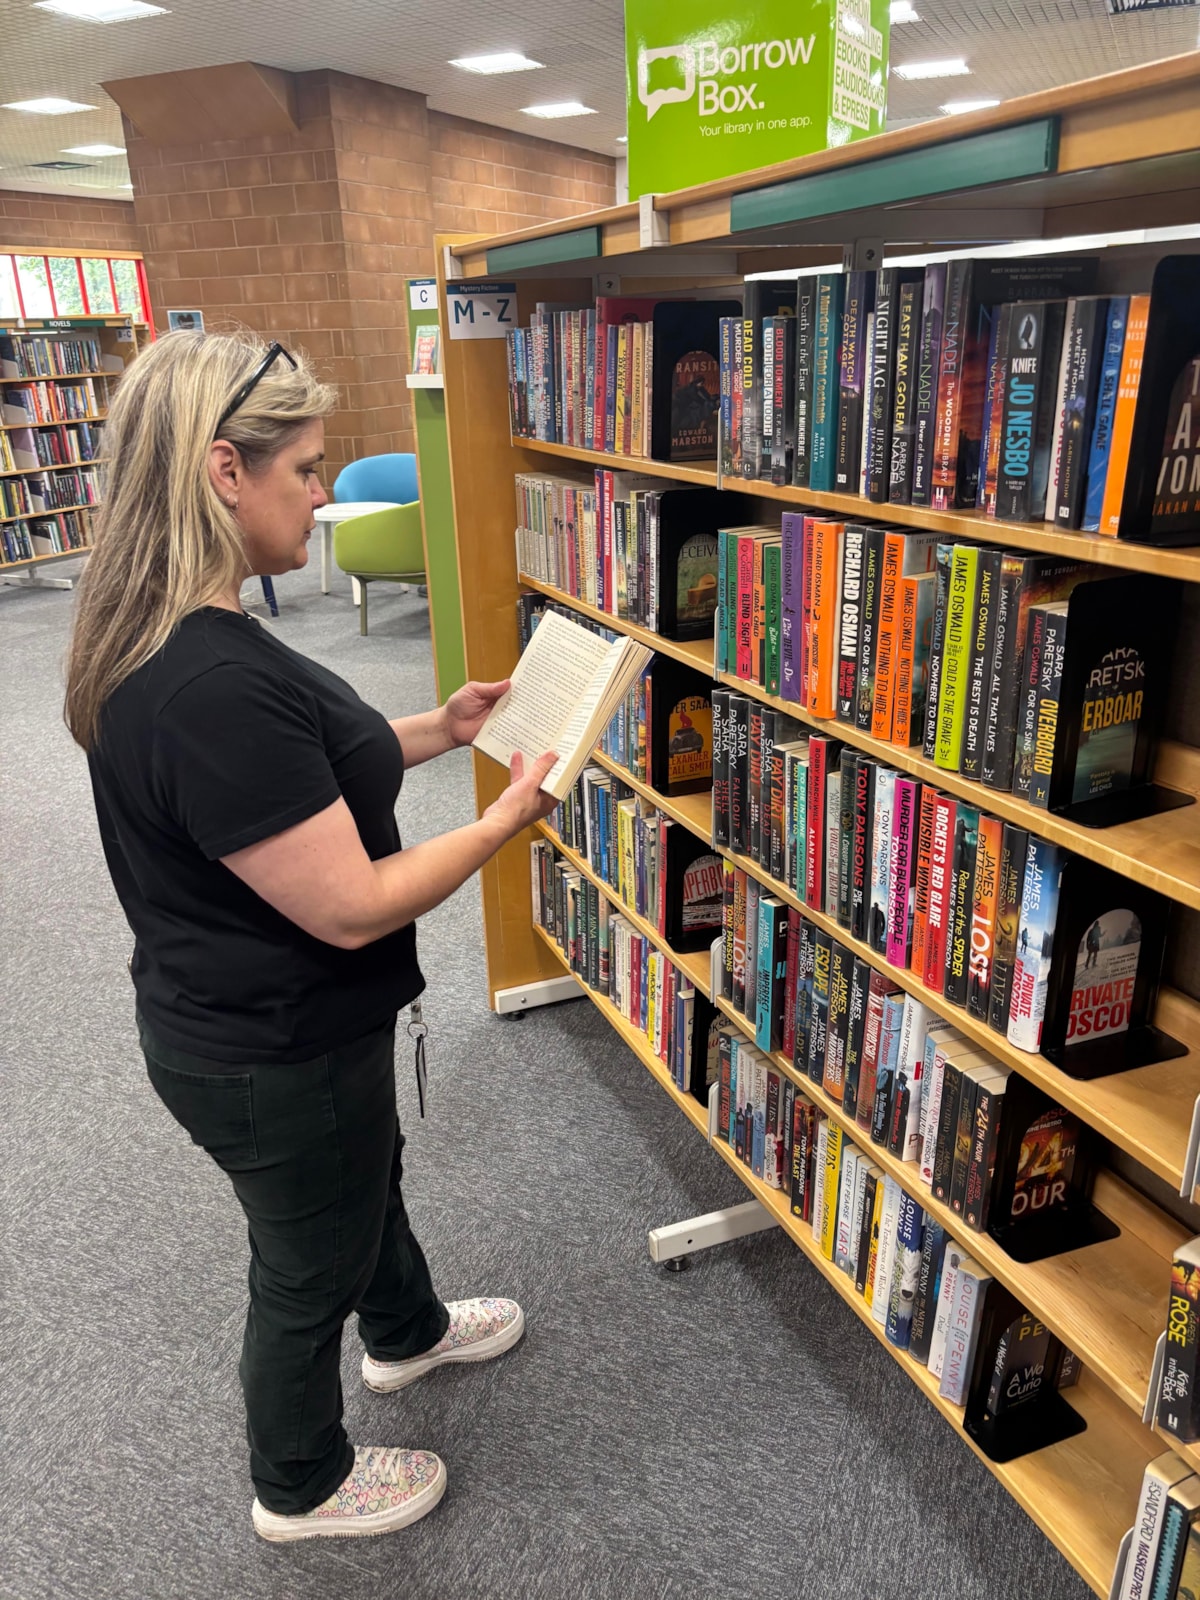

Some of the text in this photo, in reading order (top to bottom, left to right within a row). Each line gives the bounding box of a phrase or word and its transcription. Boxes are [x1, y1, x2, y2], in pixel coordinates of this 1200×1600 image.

[699, 34, 816, 77] Borrow
[699, 80, 765, 116] Box.
[835, 66, 883, 107] EAUDIOBOOKS
[699, 115, 813, 137] Your library in one app.
[842, 96, 868, 124] EPRESS
[420, 289, 428, 303] C
[454, 300, 475, 324] M
[497, 299, 511, 322] Z
[818, 295, 830, 334] Murder
[49, 320, 71, 328] NOVELS
[744, 320, 753, 353] DEAD
[841, 314, 849, 369] COTTAGE
[847, 300, 857, 382] DEATH WATCH
[923, 322, 932, 360] BARBARA
[676, 360, 718, 373] RANSIT
[774, 328, 783, 408] BLOOD TORMENT
[797, 295, 810, 456] Death in the East ABIR MUKHERJEE
[895, 305, 911, 431] EAST HAM GOLEM
[1011, 358, 1037, 373] KNIFE
[917, 364, 932, 415] NADEL
[940, 322, 959, 483] NADEL The WOODEN LIBRARY
[672, 435, 713, 446] MARSTON
[679, 428, 707, 436] EDWARD
[918, 420, 926, 442] River
[1004, 378, 1034, 476] JO NESBO
[915, 466, 923, 488] Dead
[841, 533, 863, 656] RiCHARD OSMAN
[741, 622, 749, 647] SIGHT
[874, 542, 899, 715] JAMES OSWALD NOTHING TO HIDE
[940, 554, 968, 745] JAMES OSWALD COLD AS THE GRAVE
[967, 570, 991, 751] JAMES OSWALD THE REST IS DEATH
[1053, 645, 1064, 678] SARA
[846, 663, 855, 698] We Solve
[1086, 661, 1145, 688] RETSK
[1034, 629, 1059, 775] PARETSKY OVERBOARD
[1083, 690, 1143, 733] ERBOAR
[729, 709, 737, 769] PARETSKY
[738, 724, 747, 757] SARA
[672, 751, 708, 766] EXANDER
[854, 767, 867, 886] TONY PARSONS
[893, 787, 911, 945] MURDER FOR BUSY PEOPLE
[929, 805, 949, 928] ROCKET'S RED GLARE
[589, 915, 598, 939] MINA
[951, 869, 970, 977] Return of the SPIDER
[968, 914, 991, 983] LOST
[814, 944, 830, 995] ESCAPE
[1019, 972, 1035, 1018] PRIVATE
[1071, 976, 1134, 1011] RIVATE
[810, 1002, 820, 1061] PATTERSON
[817, 1020, 826, 1053] JAMES
[826, 1031, 837, 1082] MURDERS
[835, 1038, 844, 1086] COAST-TO-COAST
[980, 1096, 989, 1112] THE
[826, 1129, 839, 1169] WILDS
[974, 1141, 986, 1162] HOUR
[792, 1160, 800, 1179] LAST
[838, 1160, 854, 1255] LESLEY PEARSE LIAR
[1011, 1182, 1065, 1216] OUR
[885, 1213, 893, 1227] The
[880, 1228, 892, 1262] Tenderness
[919, 1227, 934, 1295] LOUISE PENNY
[877, 1275, 888, 1298] Wolves
[1167, 1296, 1190, 1347] ROSE
[1185, 1310, 1198, 1345] KAREN
[1162, 1377, 1176, 1403] Back
[1166, 1365, 1177, 1378] the
[1176, 1370, 1189, 1398] Knife
[1139, 1486, 1161, 1542] SANDFORD
[1134, 1540, 1150, 1580] MASKED
